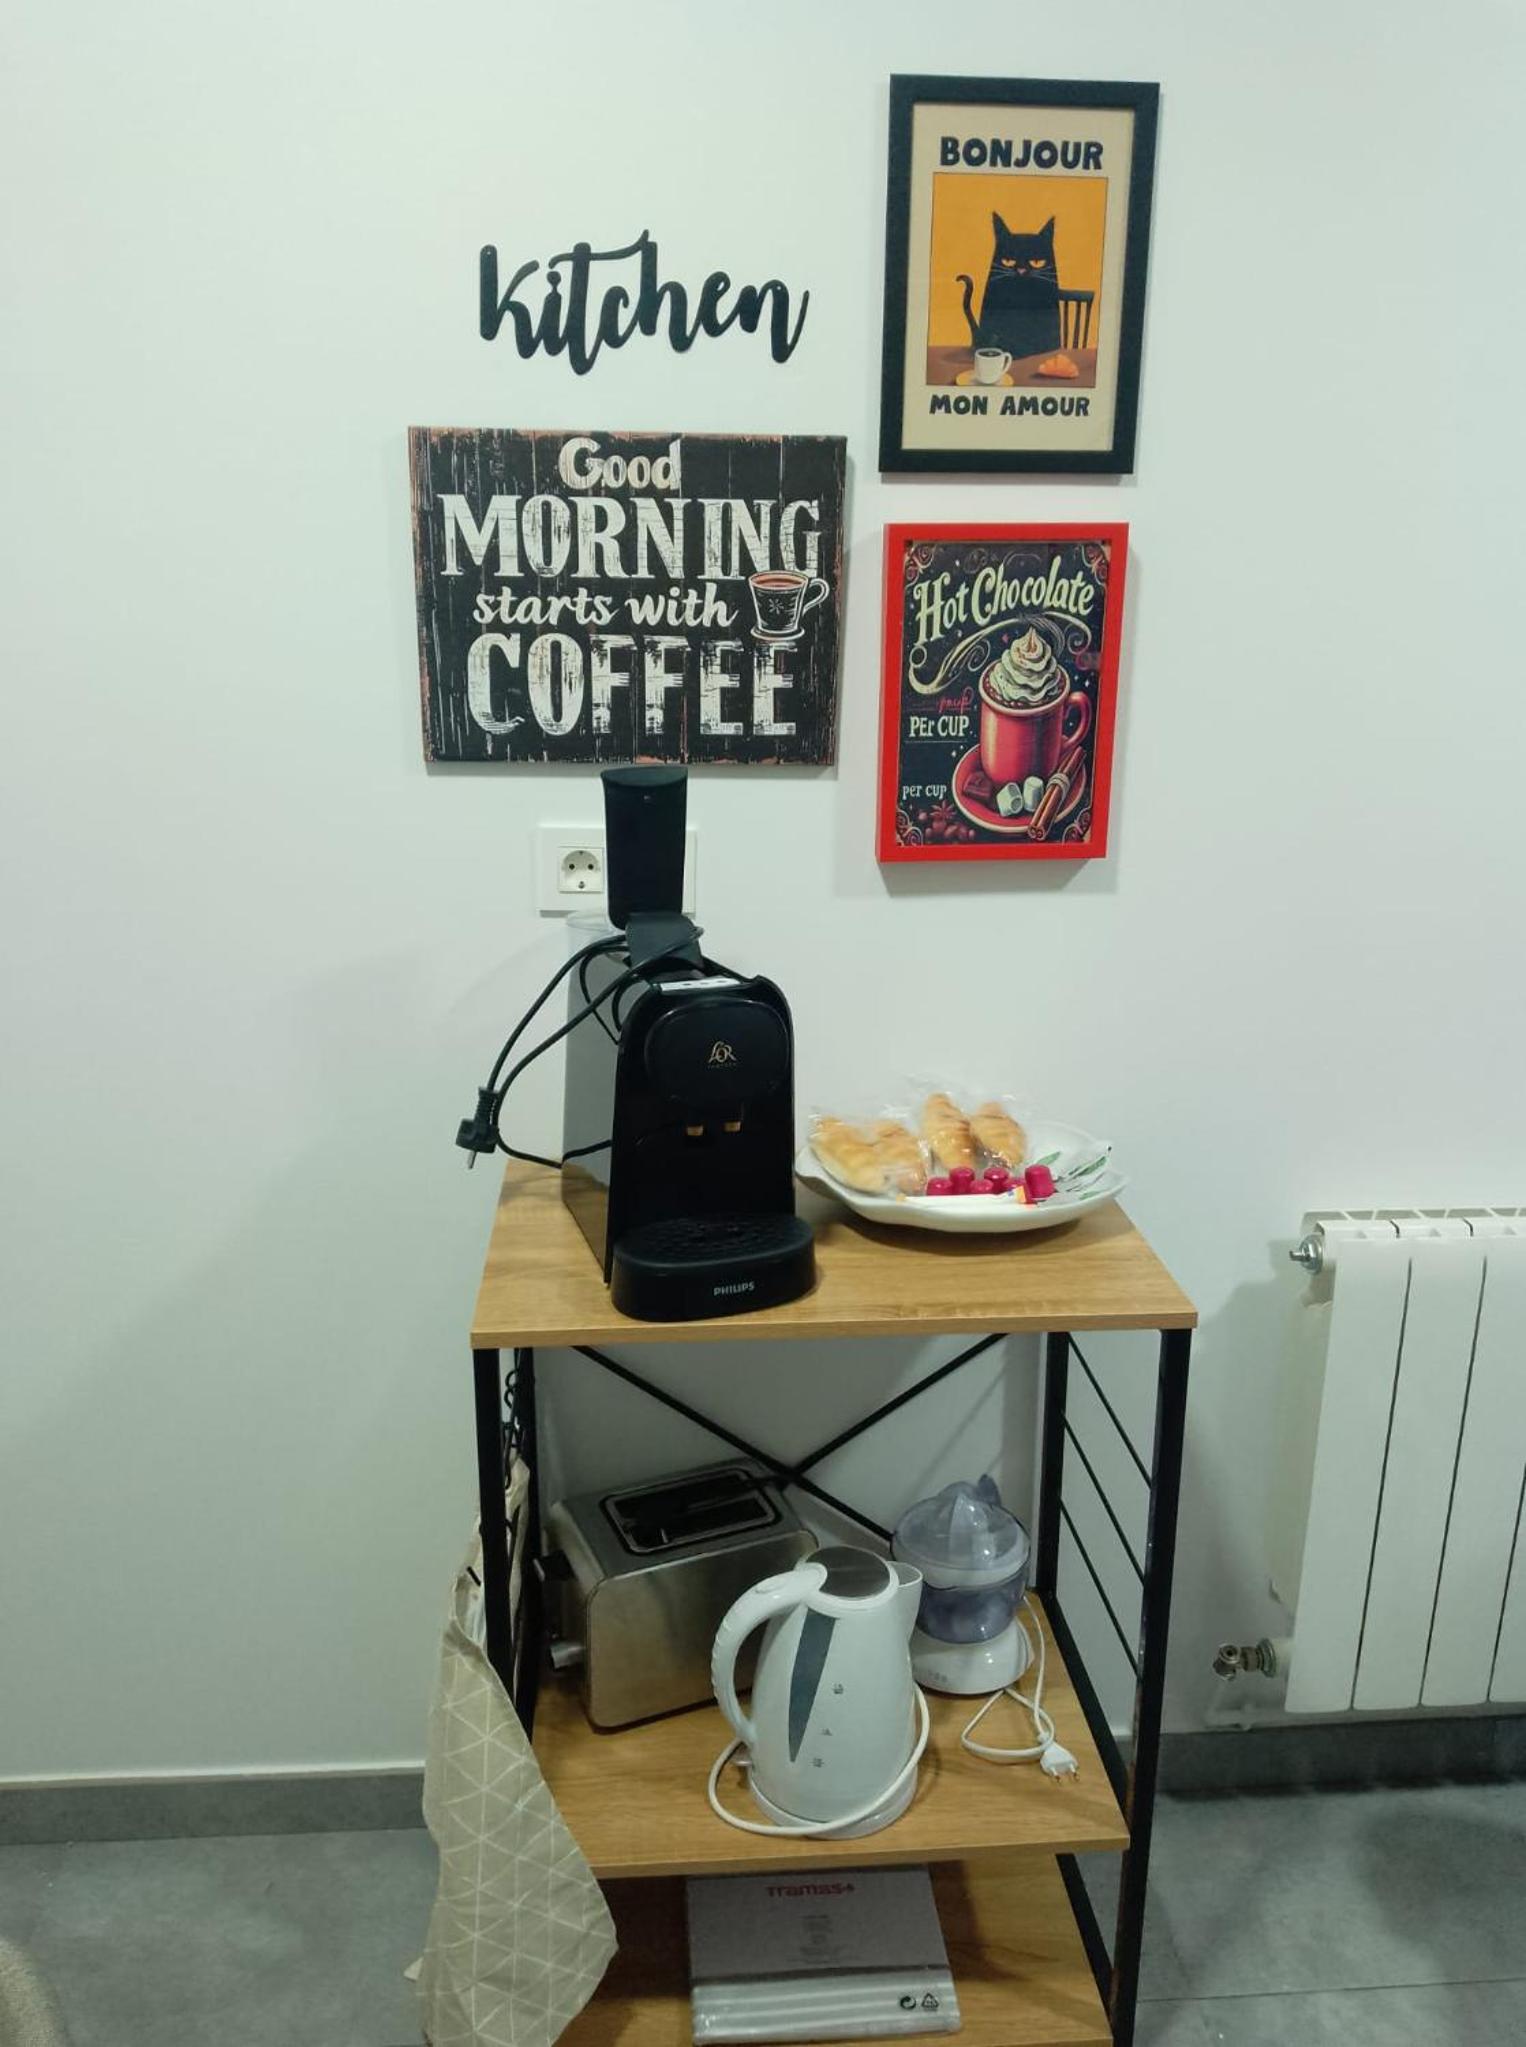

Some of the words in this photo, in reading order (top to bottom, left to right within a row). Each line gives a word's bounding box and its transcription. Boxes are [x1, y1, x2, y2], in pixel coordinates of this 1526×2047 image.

[940, 136, 1104, 171] BONJOUR
[929, 394, 989, 416] MON
[999, 395, 1091, 417] AMOUR
[558, 437, 682, 491] Good
[437, 494, 821, 579] MORNING
[472, 586, 617, 627] starts
[625, 582, 738, 628] with
[913, 571, 970, 646] Hot
[971, 555, 1096, 627] Chocolate
[467, 632, 799, 736] COFFEE
[937, 714, 970, 737] CUP
[713, 1281, 755, 1297] PHILIPS
